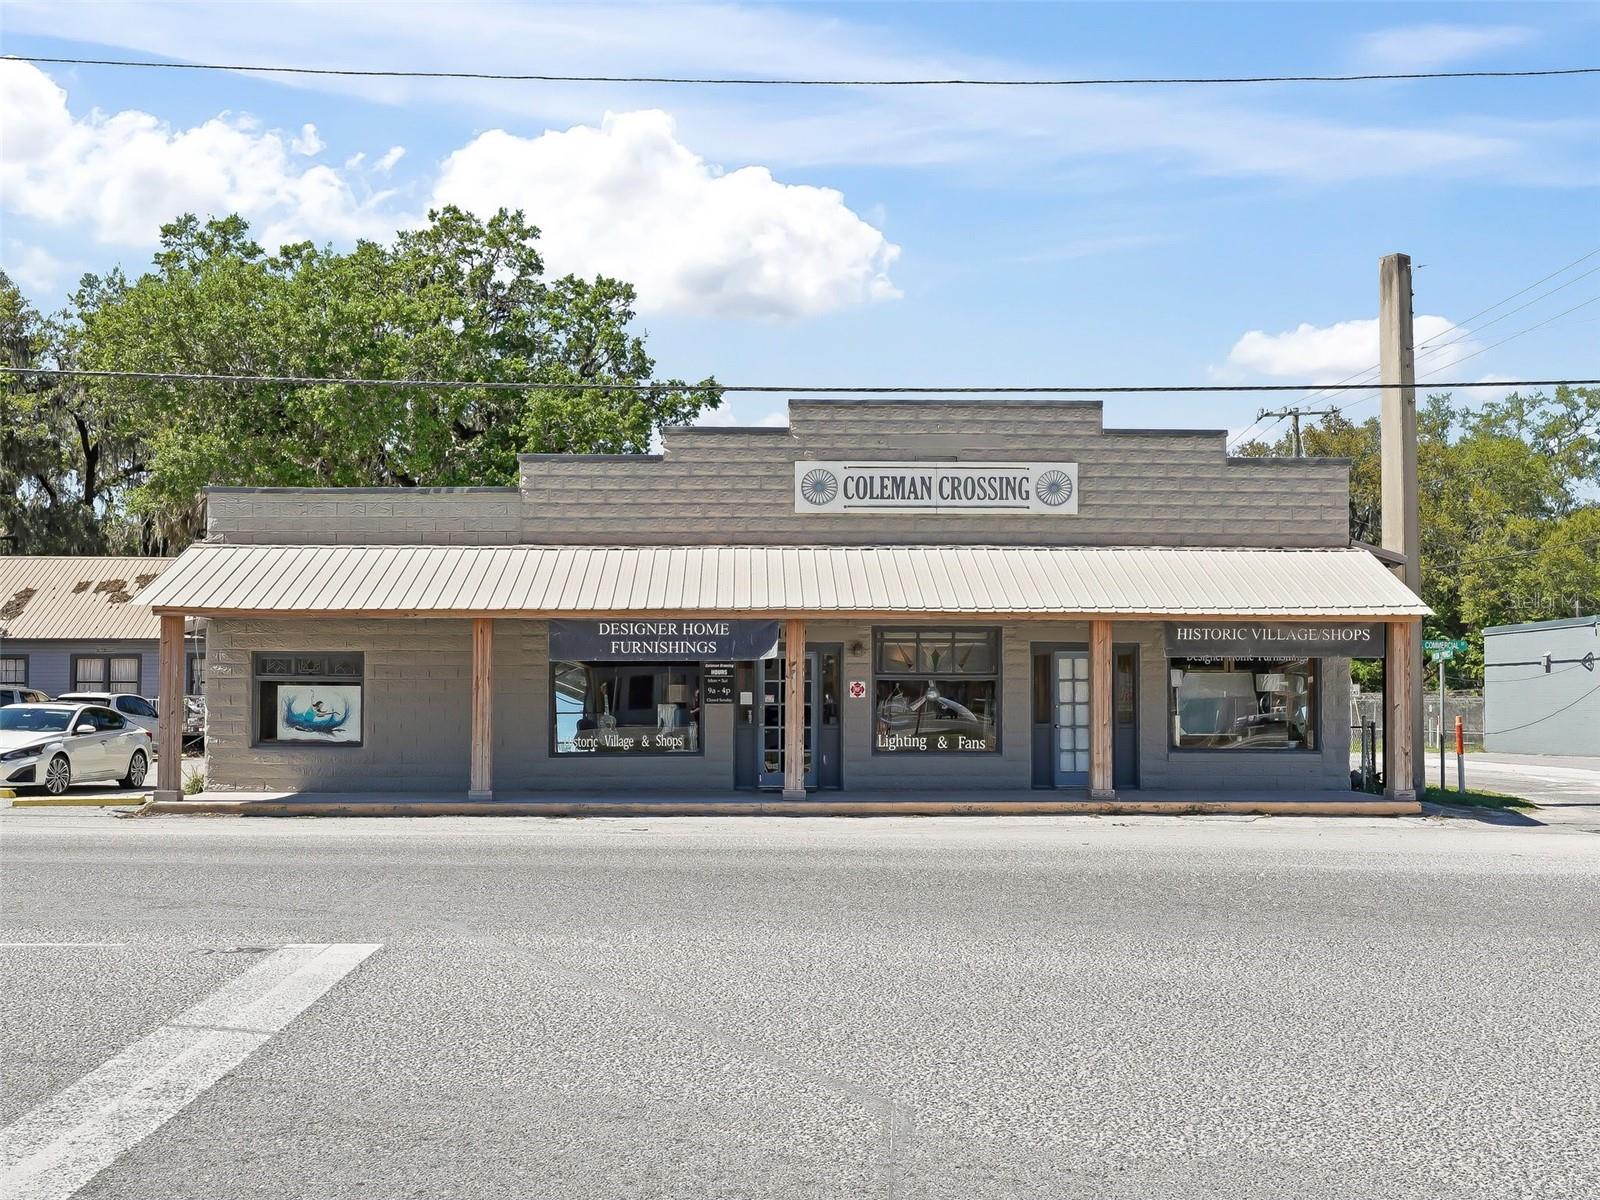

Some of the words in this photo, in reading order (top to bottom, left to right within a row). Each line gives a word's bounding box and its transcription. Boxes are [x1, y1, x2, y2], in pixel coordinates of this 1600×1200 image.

[843, 475, 932, 500] COLEMAN
[938, 476, 1030, 500] CROSSING
[599, 622, 678, 635] DESIGNER
[682, 623, 730, 635] HOME
[1176, 628, 1248, 640] HISTORIC
[1251, 628, 1371, 641] VILLAGE/SHOPS
[610, 641, 717, 654] FURNISHINGS
[722, 687, 730, 696] 4p
[604, 735, 634, 750] Village
[641, 735, 650, 747] &
[655, 734, 682, 750] Shops
[878, 734, 927, 751] Lighting
[937, 736, 948, 749] &
[958, 736, 986, 749] Fans
